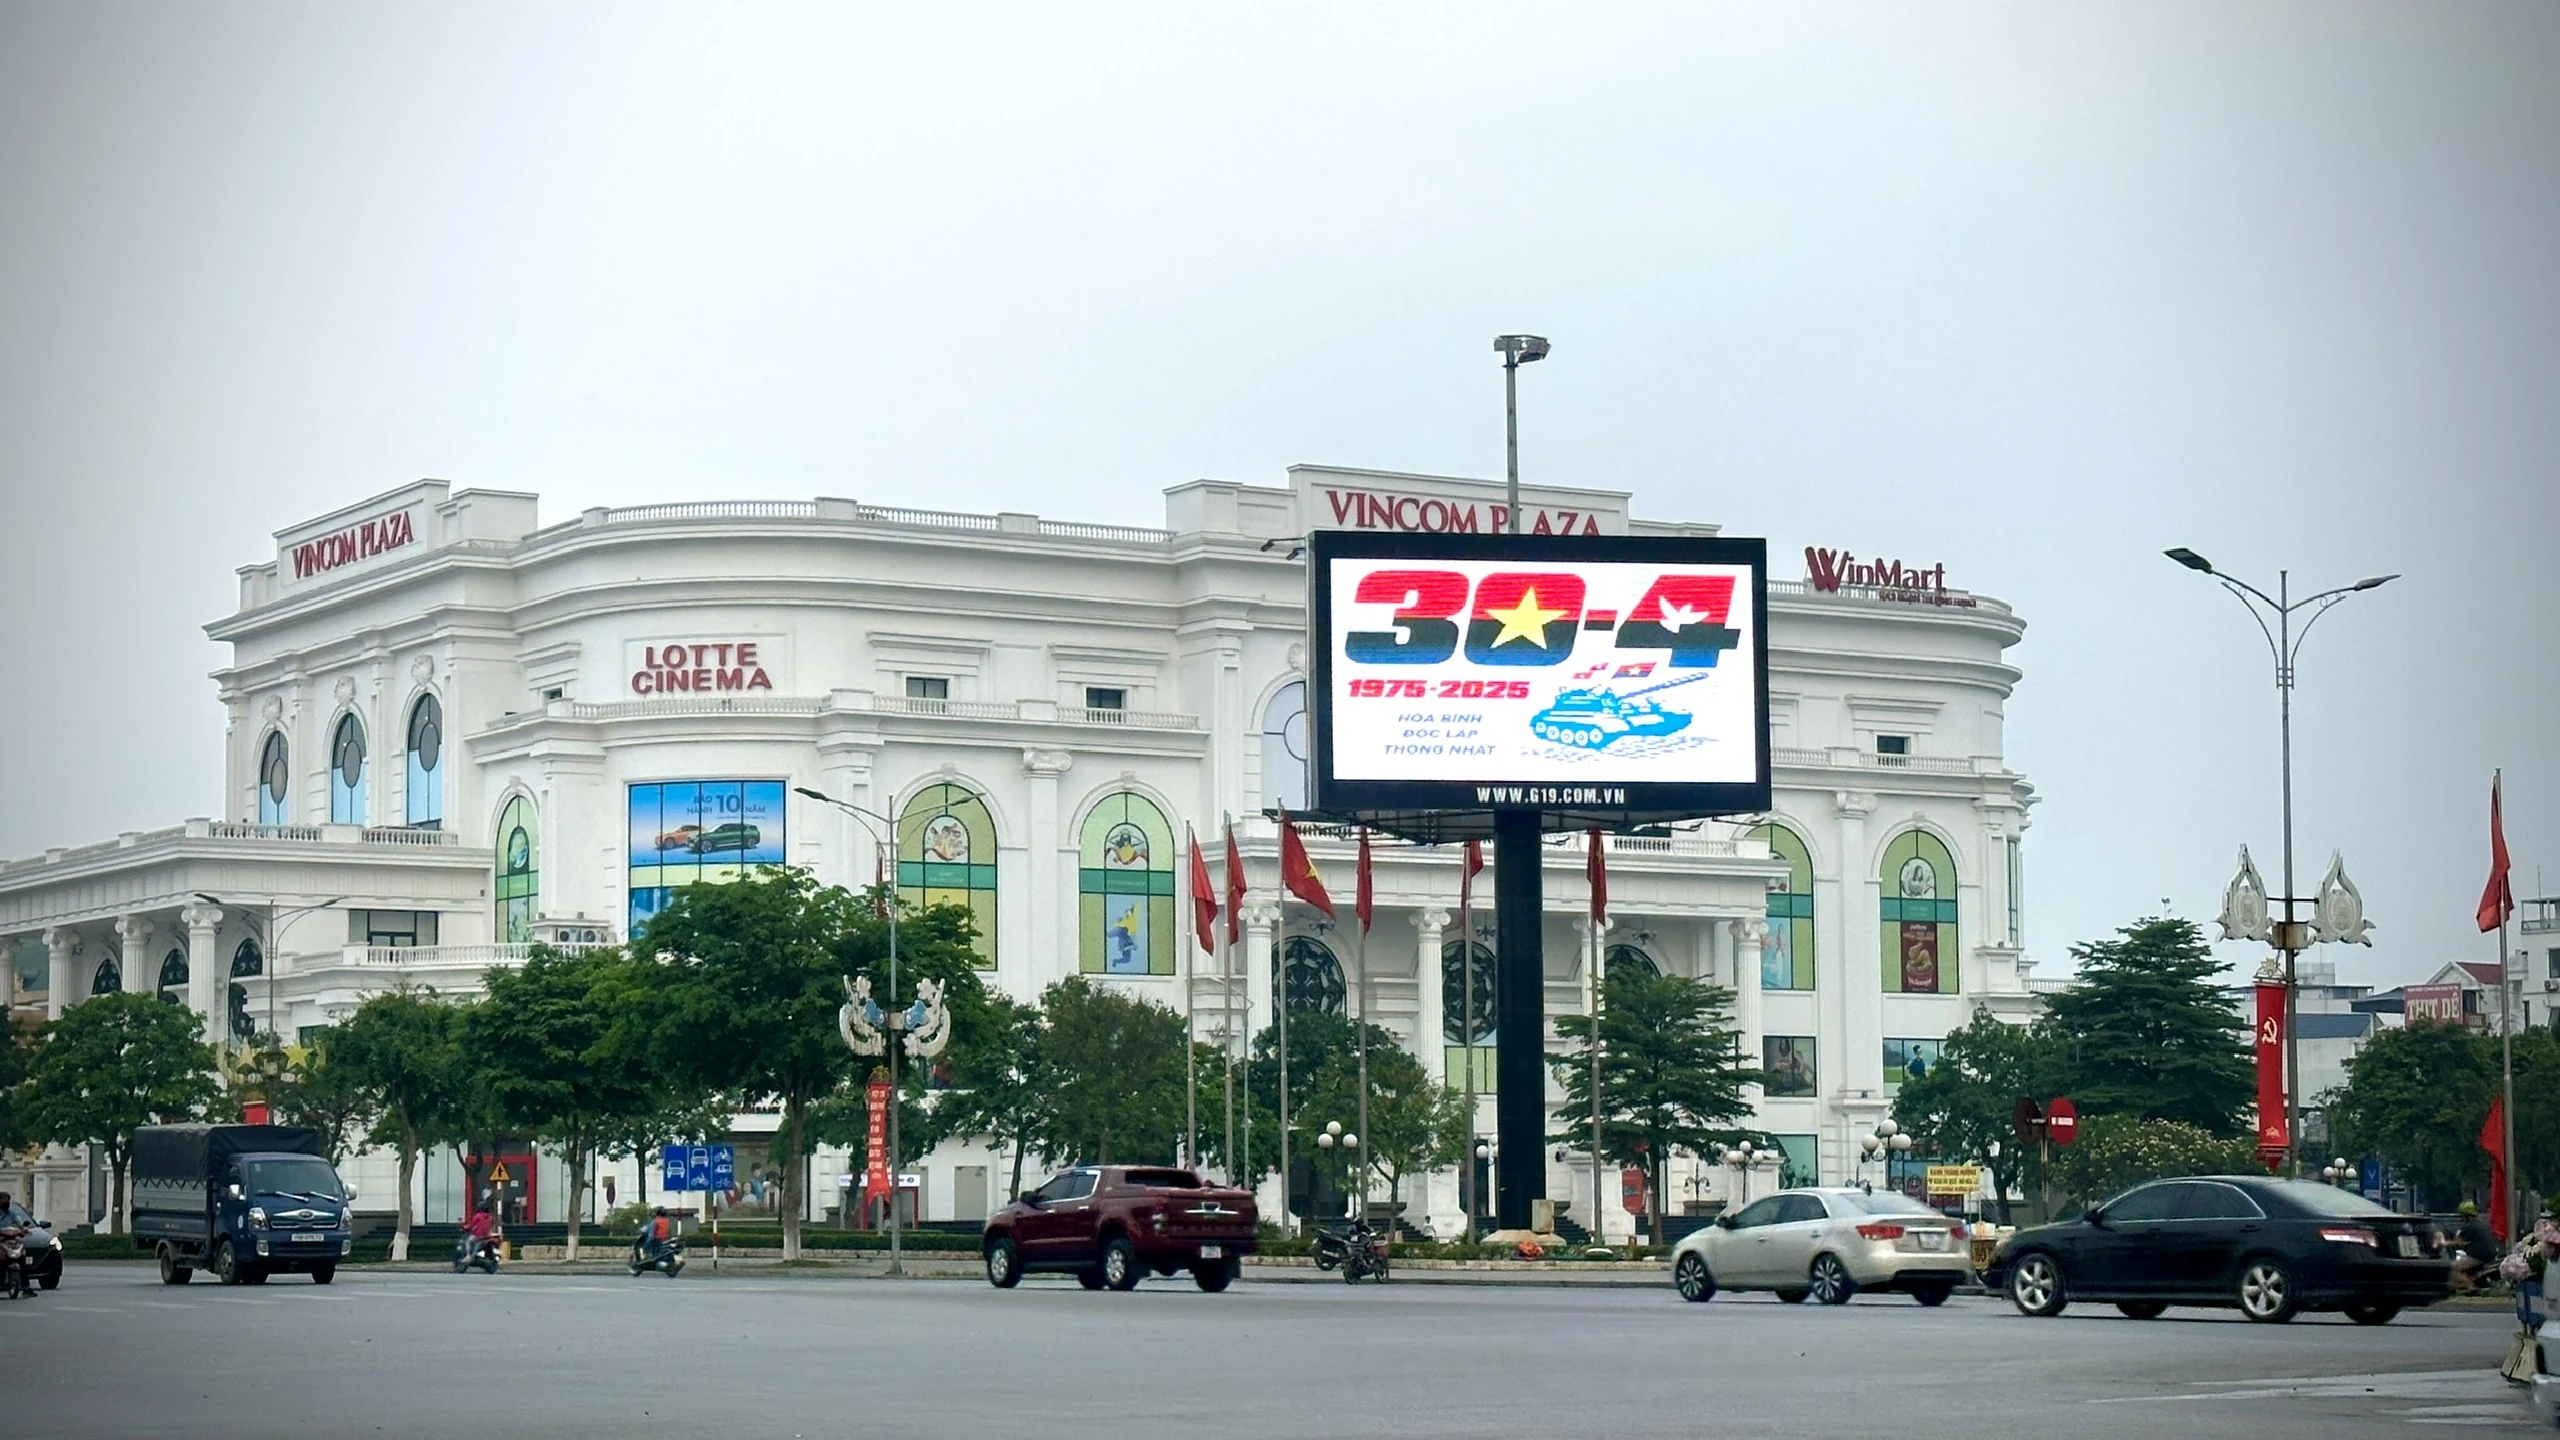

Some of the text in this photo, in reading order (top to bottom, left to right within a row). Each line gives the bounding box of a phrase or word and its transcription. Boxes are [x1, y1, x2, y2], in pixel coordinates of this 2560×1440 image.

[1326, 490, 1600, 537] VINCOM PAZA
[291, 510, 414, 579] VINCOM PLAZA
[1804, 546, 1946, 592] WinMart
[1345, 570, 1741, 667] 30-4
[645, 643, 758, 669] LOTTE
[631, 667, 773, 694] CINEMA
[1348, 679, 1531, 699] 1975-2025
[715, 794, 741, 813] 10
[1476, 786, 1625, 804] WWW.G19.COM.VN
